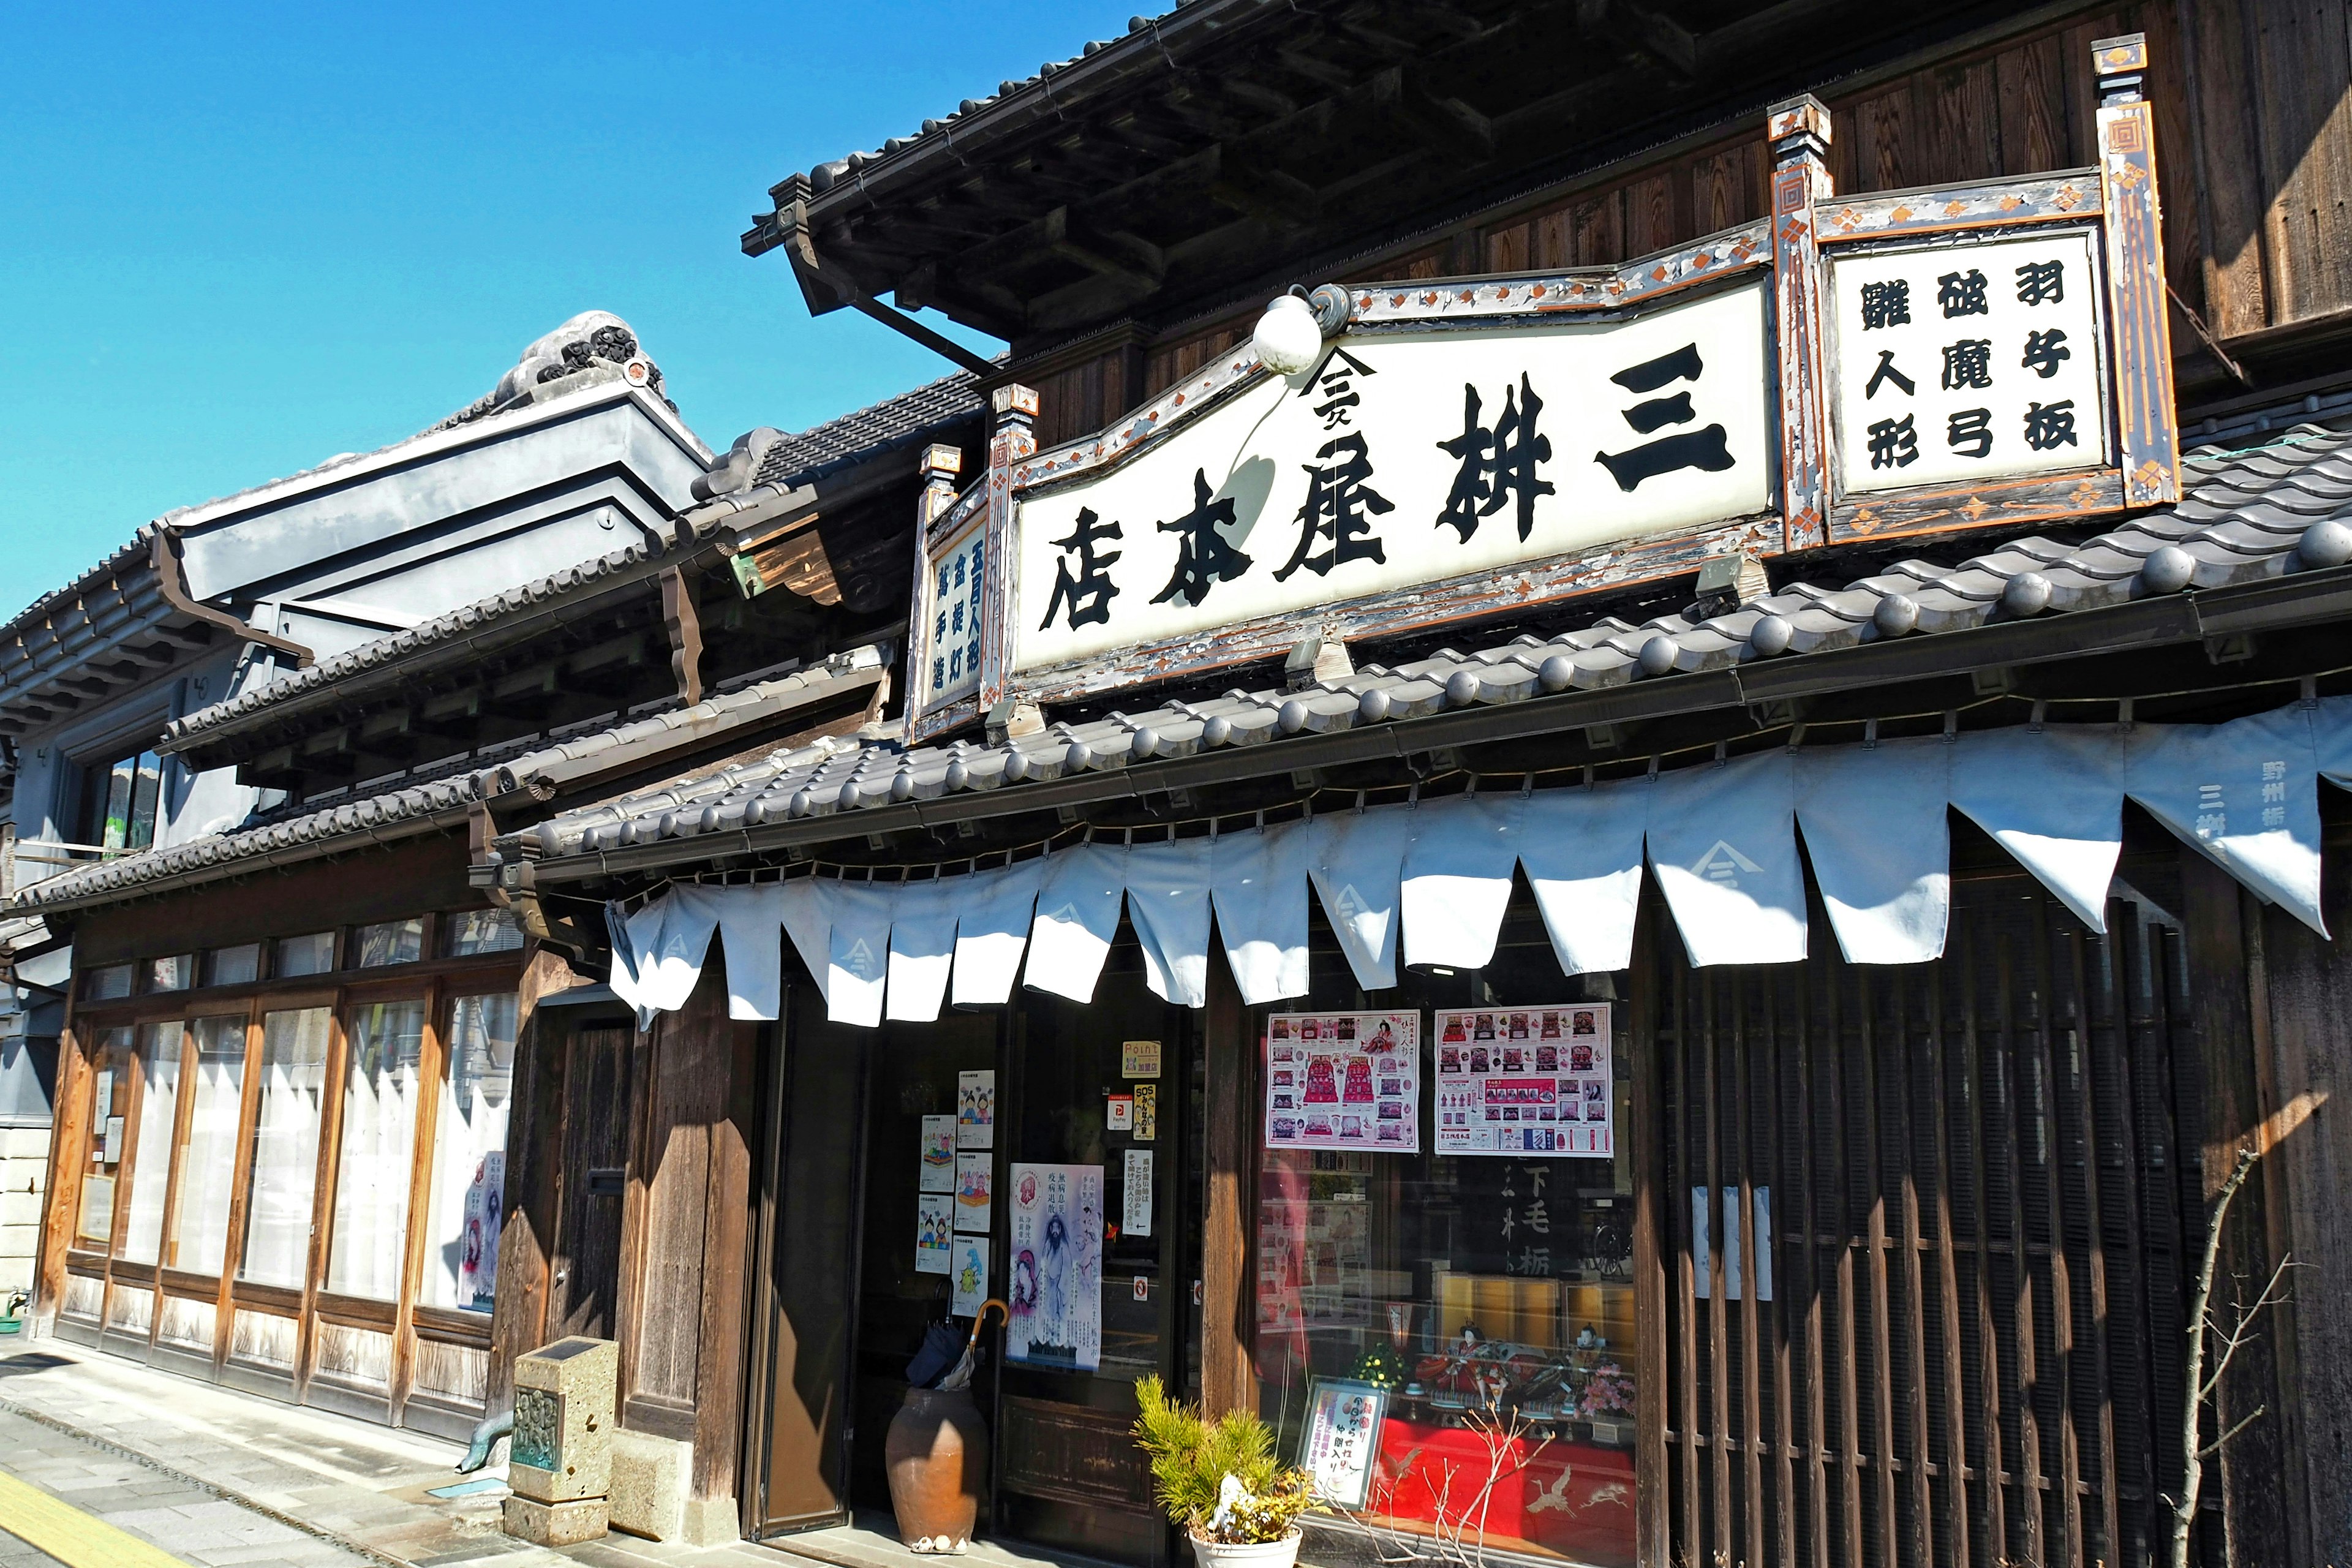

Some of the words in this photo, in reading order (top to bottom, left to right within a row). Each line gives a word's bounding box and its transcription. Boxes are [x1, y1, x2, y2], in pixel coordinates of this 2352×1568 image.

[1860, 279, 1920, 470] 雛人形
[1937, 268, 1992, 458] 破魔弓
[2015, 259, 2078, 451] 羽子板
[949, 554, 966, 684] 盆提灯
[2261, 760, 2286, 831] 野州栃
[1125, 1043, 1158, 1055] Point
[1136, 1086, 1153, 1097] SOS
[1047, 1172, 1056, 1214] 疫病退散
[1330, 1424, 1346, 1472] 仲間入り
